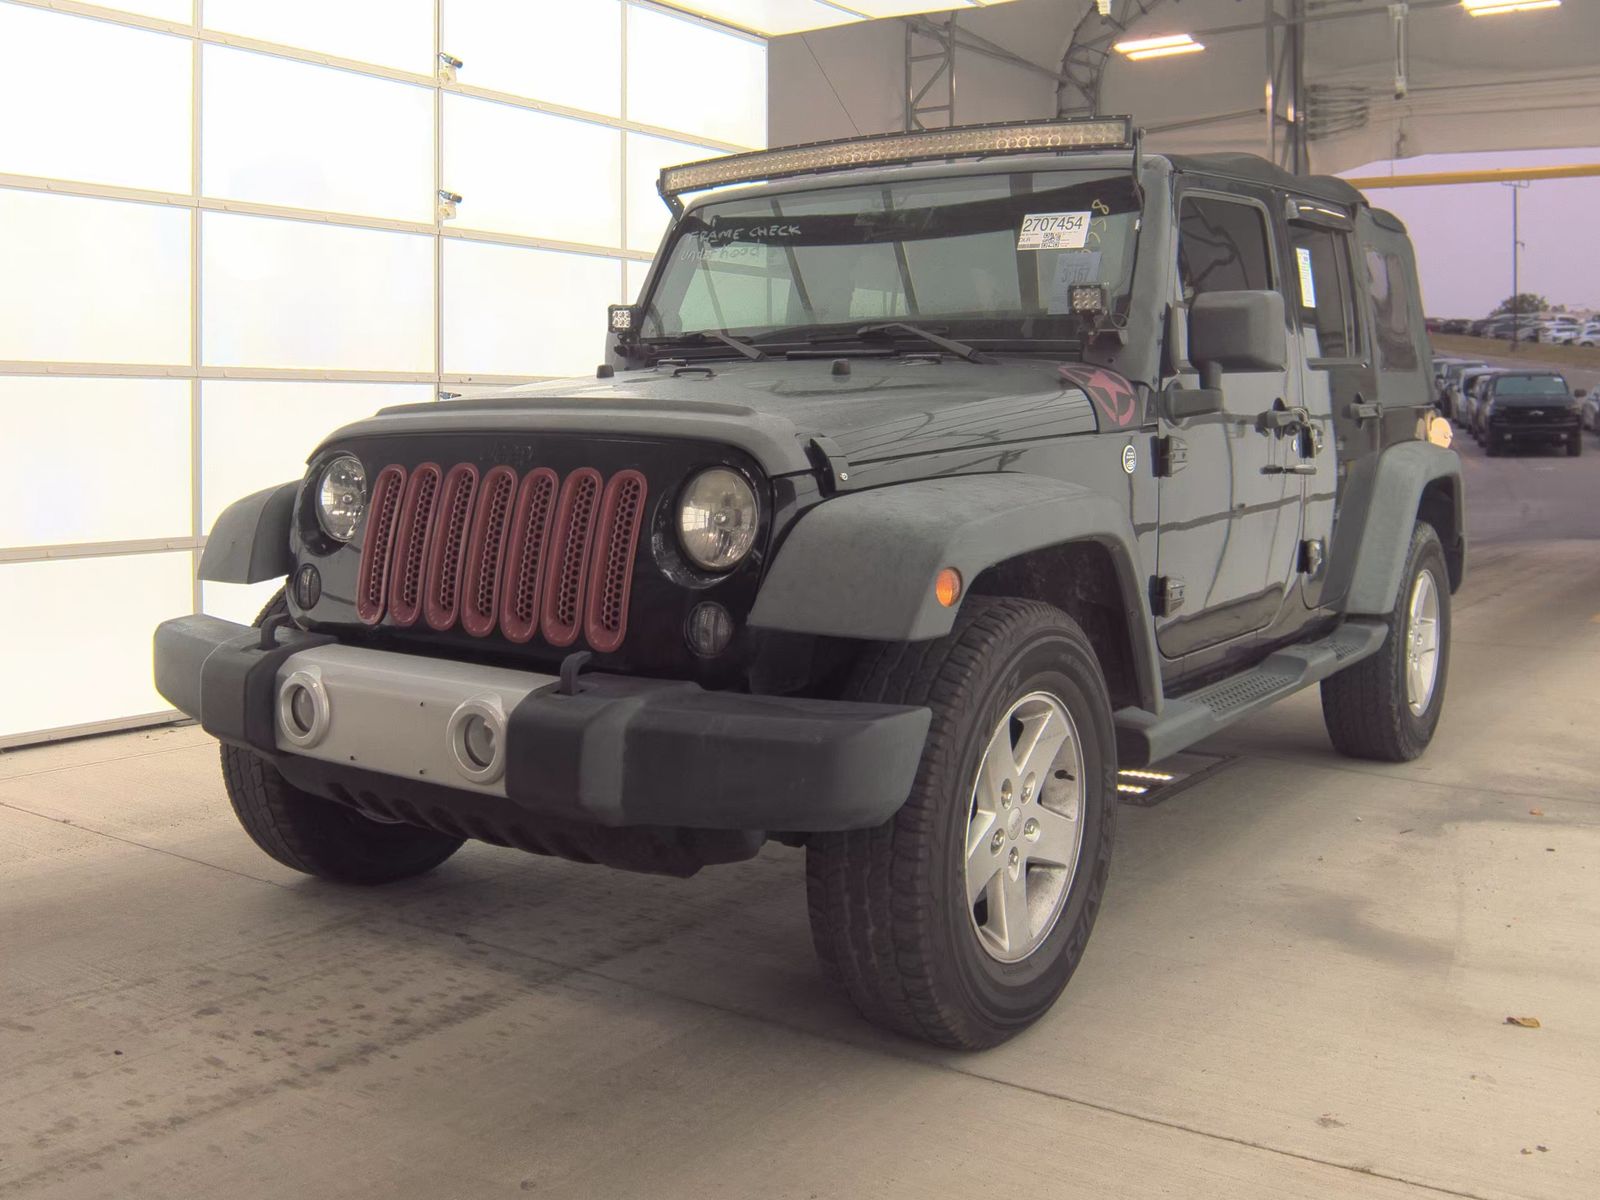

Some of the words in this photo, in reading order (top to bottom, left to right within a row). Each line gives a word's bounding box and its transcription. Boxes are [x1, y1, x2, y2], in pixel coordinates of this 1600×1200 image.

[1022, 216, 1083, 232] 2707454
[690, 227, 745, 242] FRAME
[749, 224, 802, 237] CHECK
